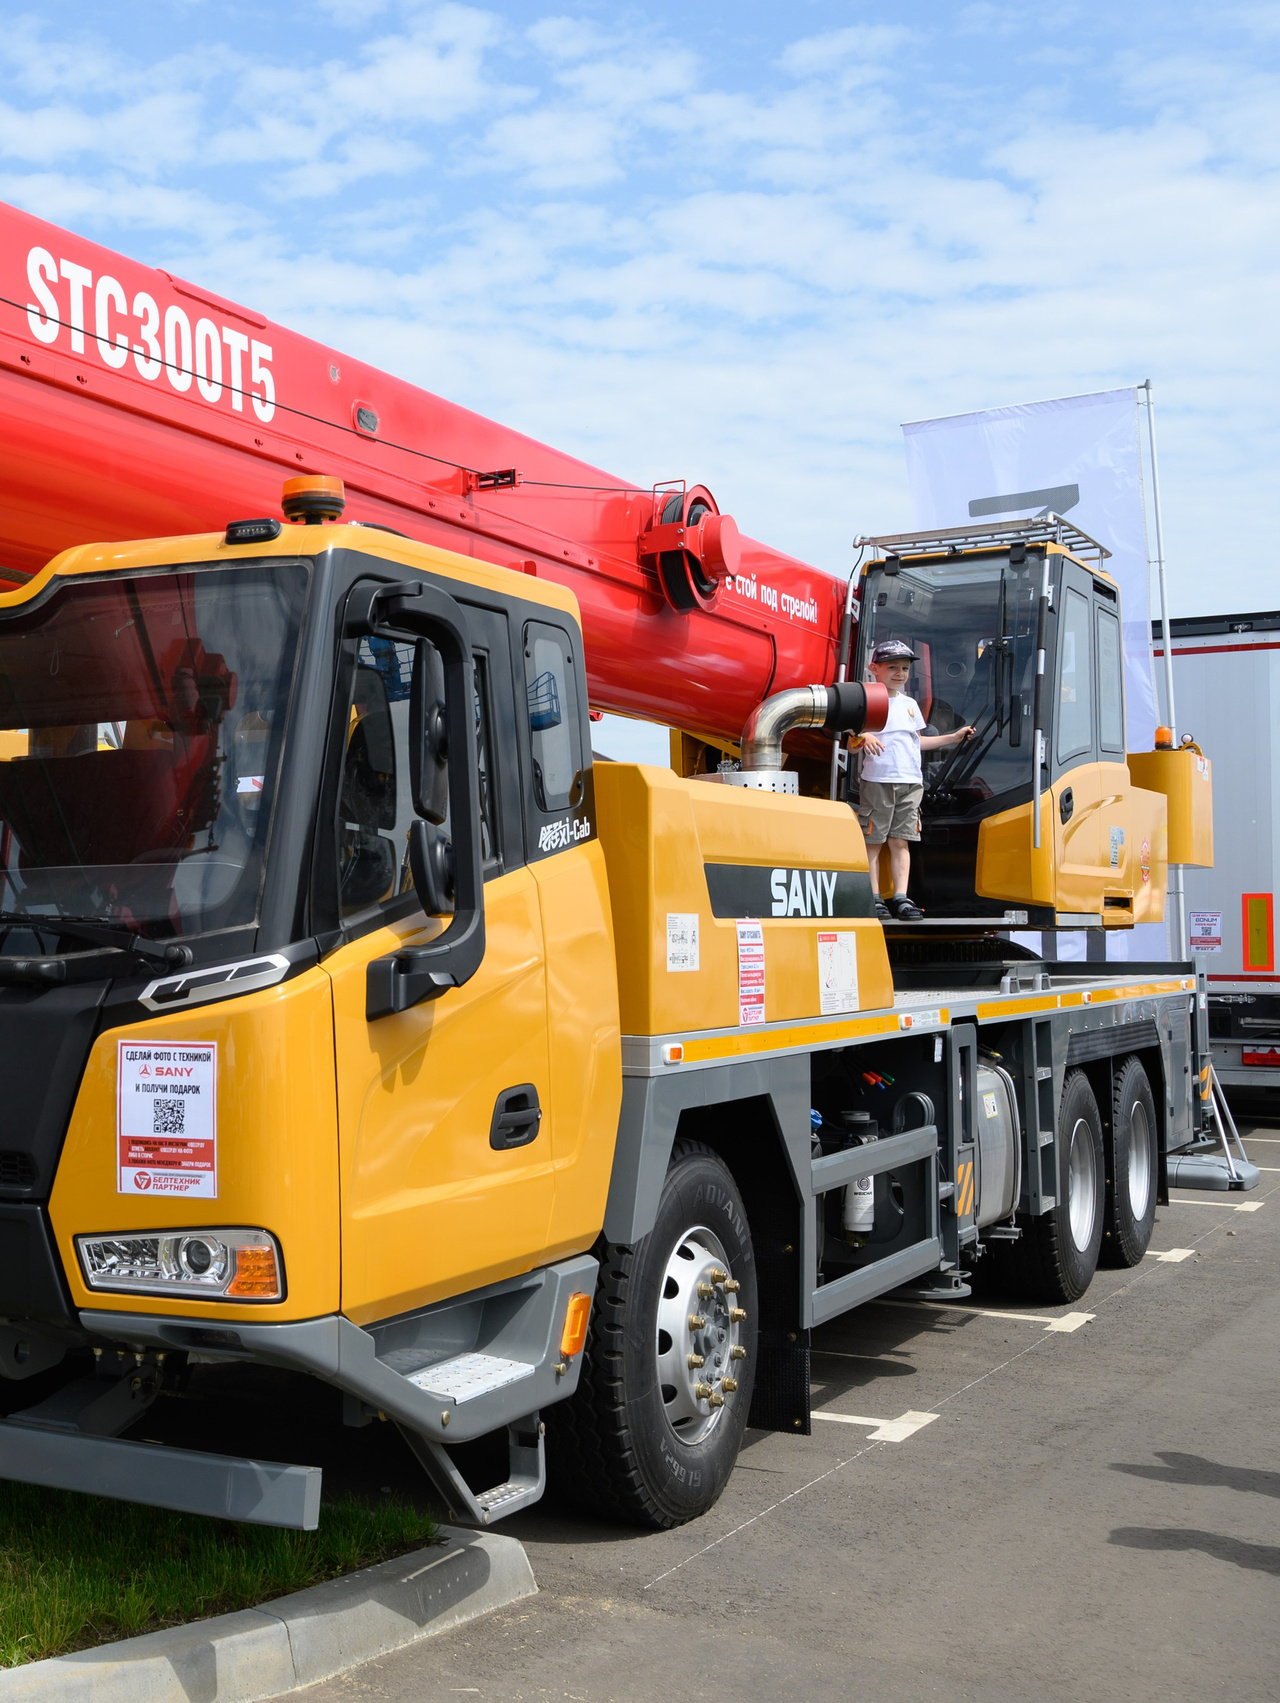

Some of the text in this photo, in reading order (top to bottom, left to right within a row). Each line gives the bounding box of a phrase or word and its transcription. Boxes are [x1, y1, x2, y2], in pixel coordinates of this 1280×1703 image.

[26, 246, 275, 423] STC300T5
[735, 573, 757, 600] стой
[761, 584, 778, 612] под
[781, 593, 817, 624] стрелой!
[771, 868, 838, 917] SANY
[125, 1050, 211, 1062] СДЕЛАЙ ФОТО С ТЕХНИКОЙ
[155, 1067, 194, 1077] SANY
[135, 1084, 201, 1095] И ПОЛУЧИ ПОДАРОК
[153, 1176, 201, 1185] БЕЛТЕХНИК
